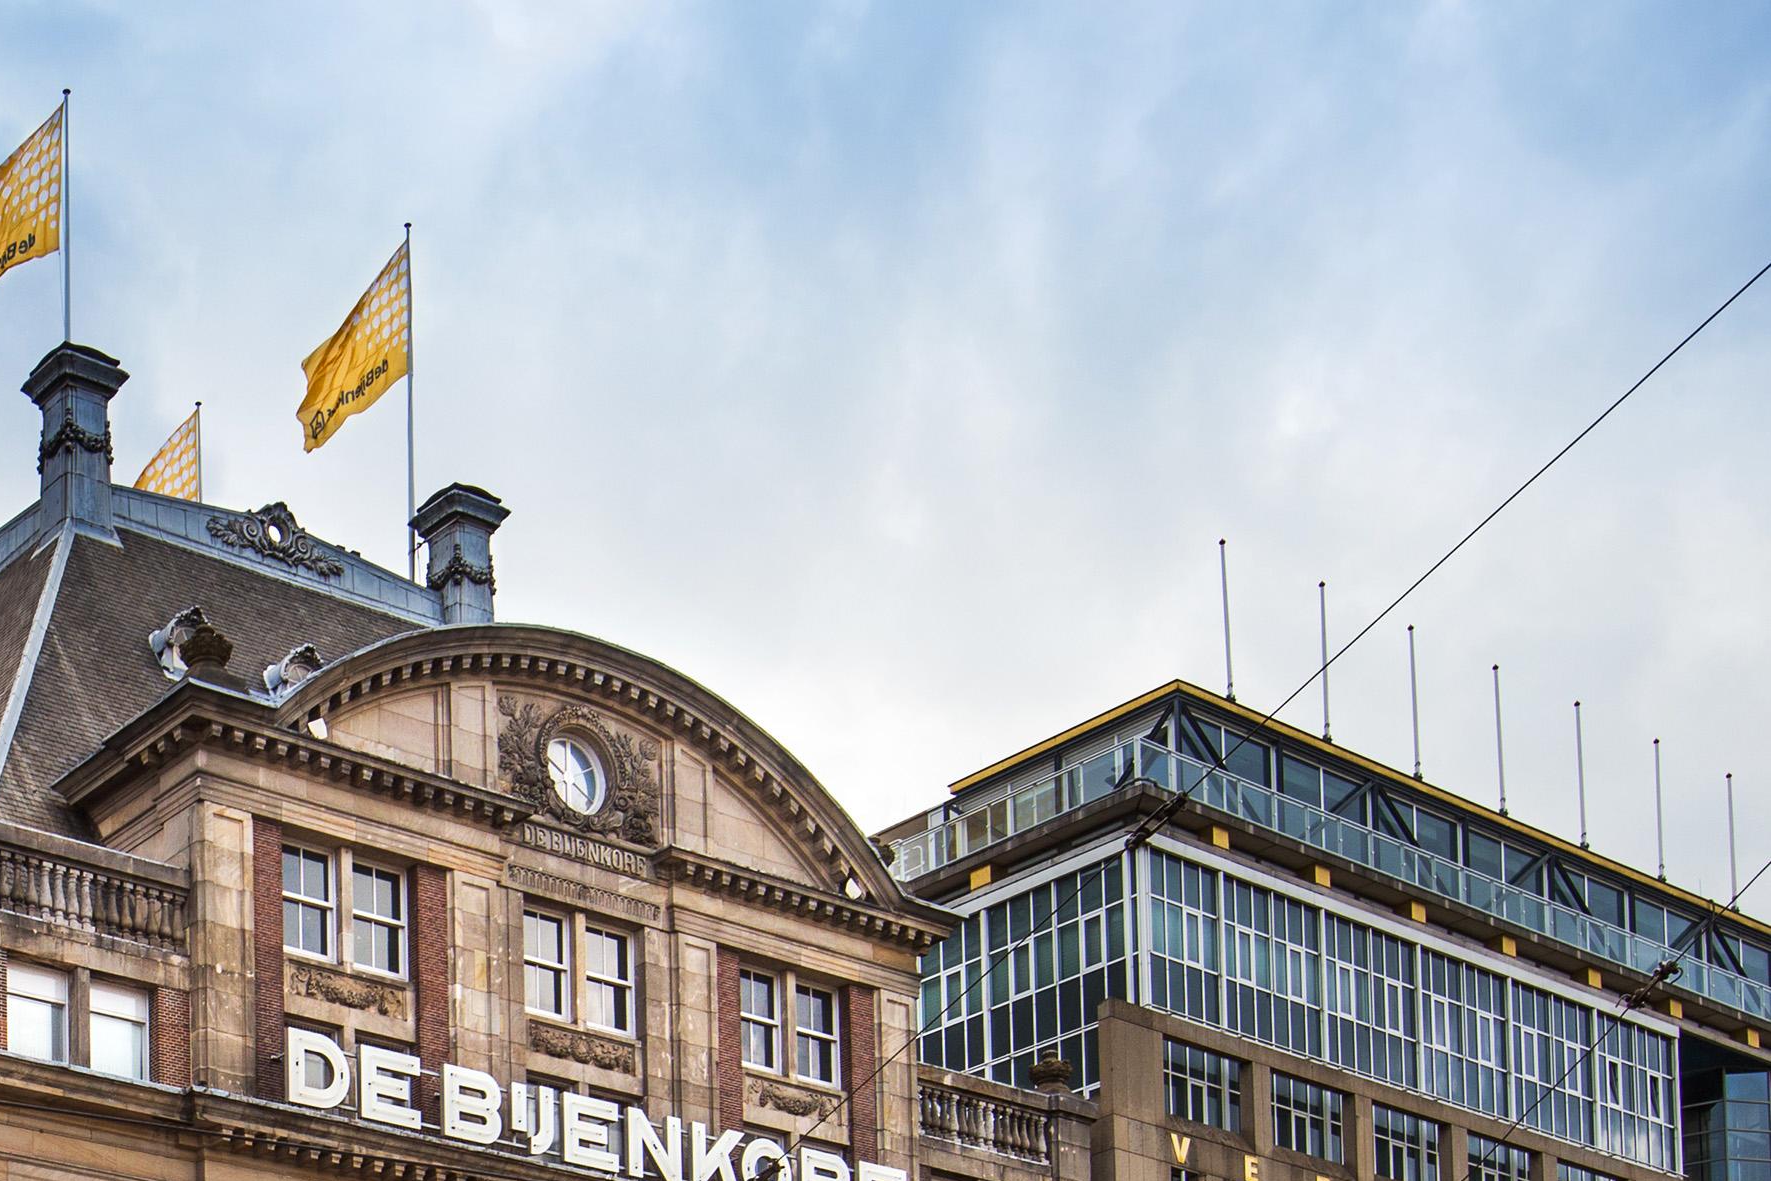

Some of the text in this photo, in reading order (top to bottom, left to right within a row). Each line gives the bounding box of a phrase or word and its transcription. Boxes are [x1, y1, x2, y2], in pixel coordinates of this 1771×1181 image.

[523, 823, 647, 875] DE BIJENKORF
[286, 1026, 422, 1130] DE
